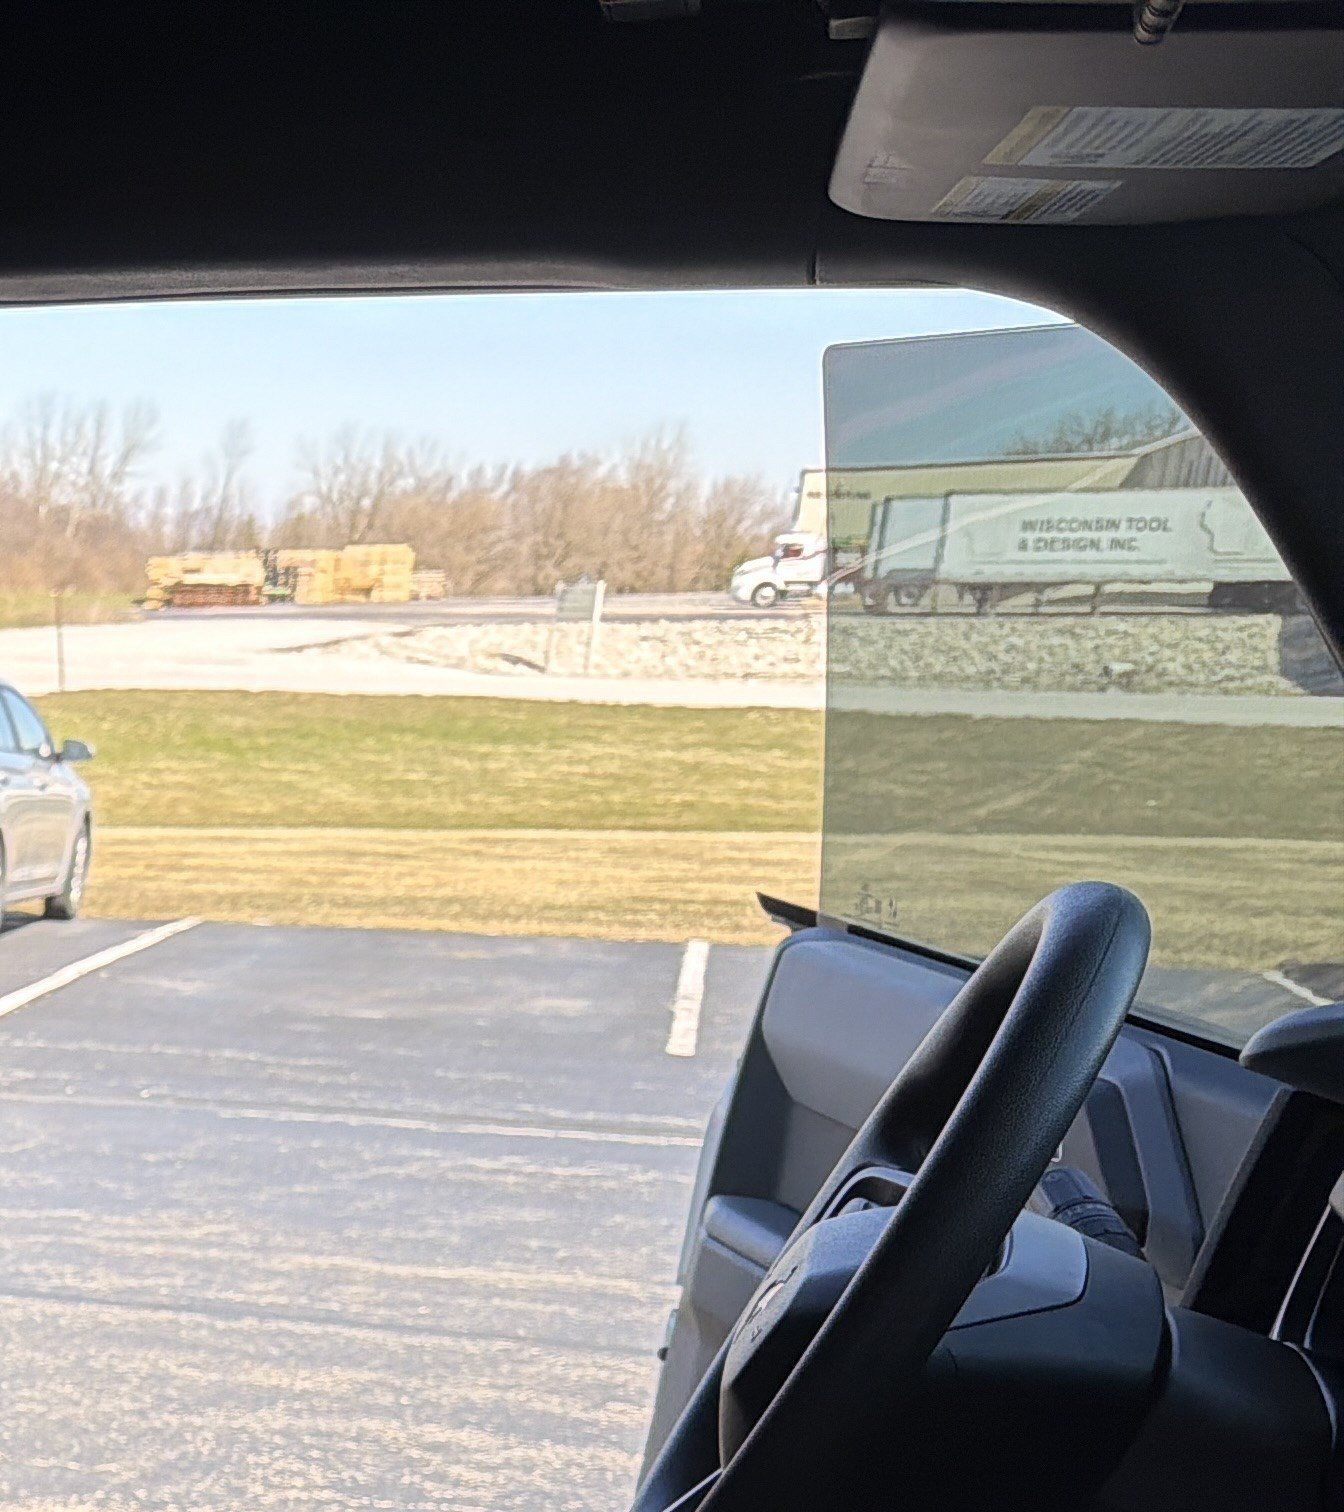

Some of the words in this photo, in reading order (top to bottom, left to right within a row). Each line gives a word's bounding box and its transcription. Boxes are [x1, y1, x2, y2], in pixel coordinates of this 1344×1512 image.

[1021, 517, 1120, 532] WISCONSIN
[1126, 516, 1172, 532] TOOL
[1018, 537, 1028, 551] &
